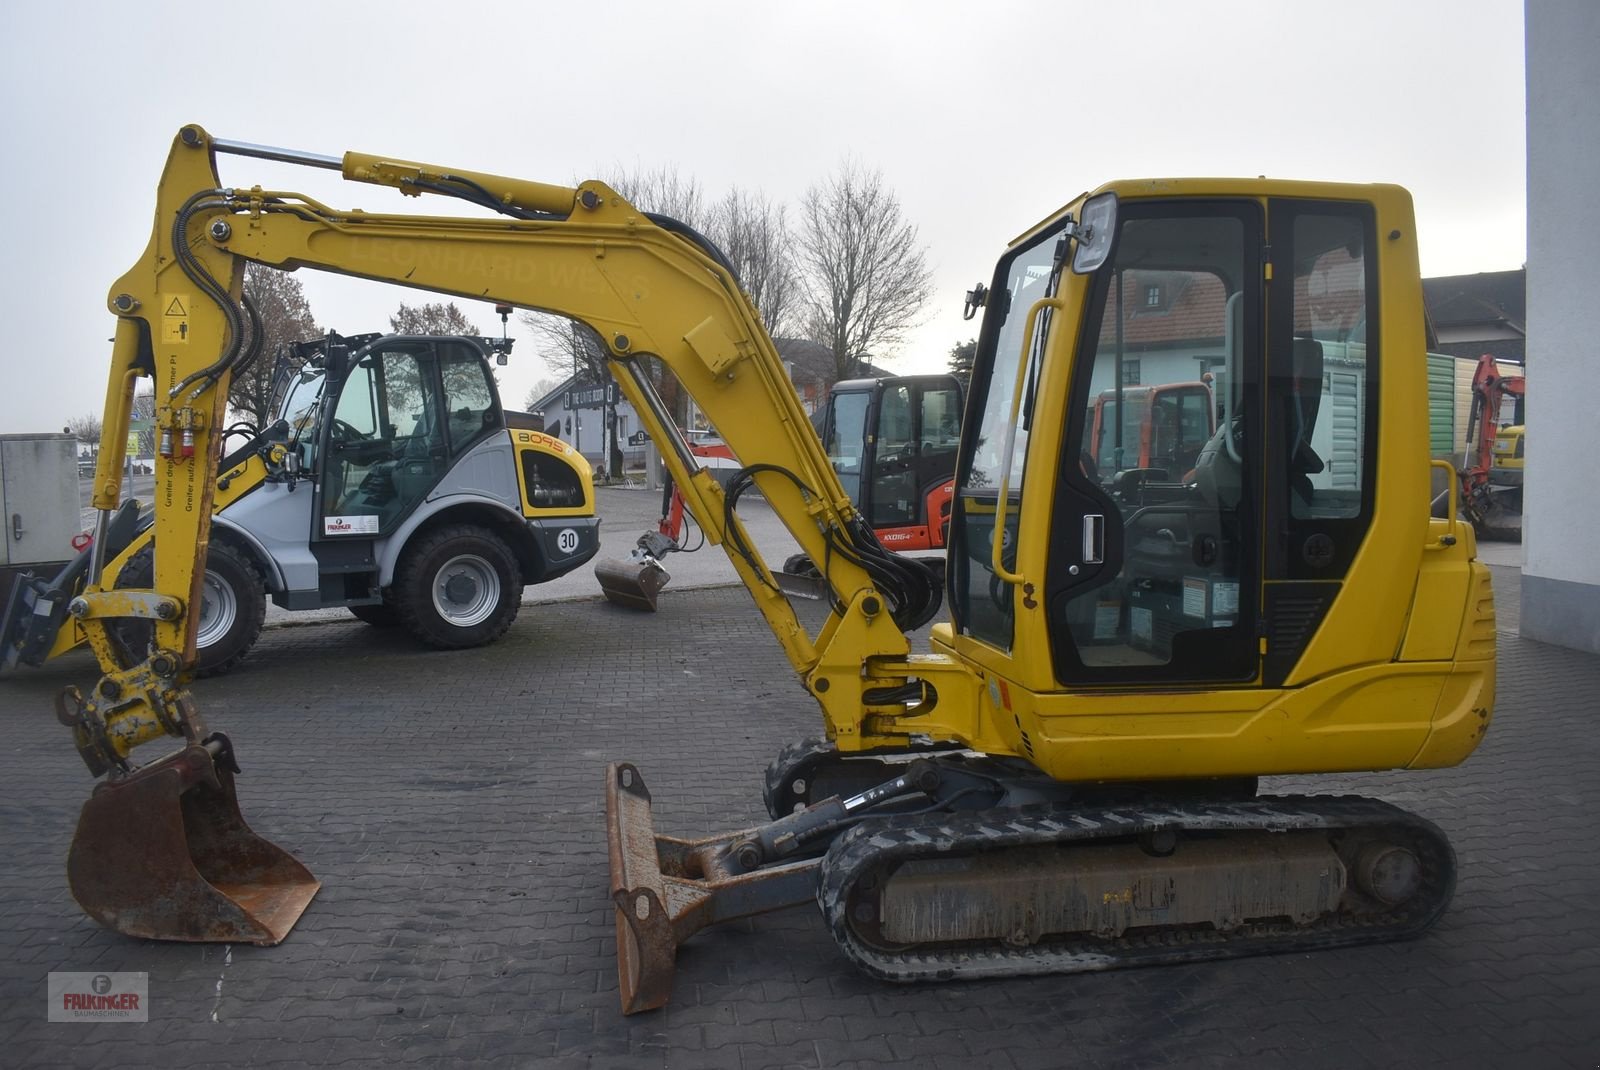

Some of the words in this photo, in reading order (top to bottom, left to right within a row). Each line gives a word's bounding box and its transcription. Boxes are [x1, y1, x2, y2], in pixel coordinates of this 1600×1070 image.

[351, 240, 536, 282] LEONHARD
[518, 433, 563, 453] 8095
[165, 458, 173, 477] dreh
[165, 480, 173, 508] Greifer
[561, 532, 575, 548] 30
